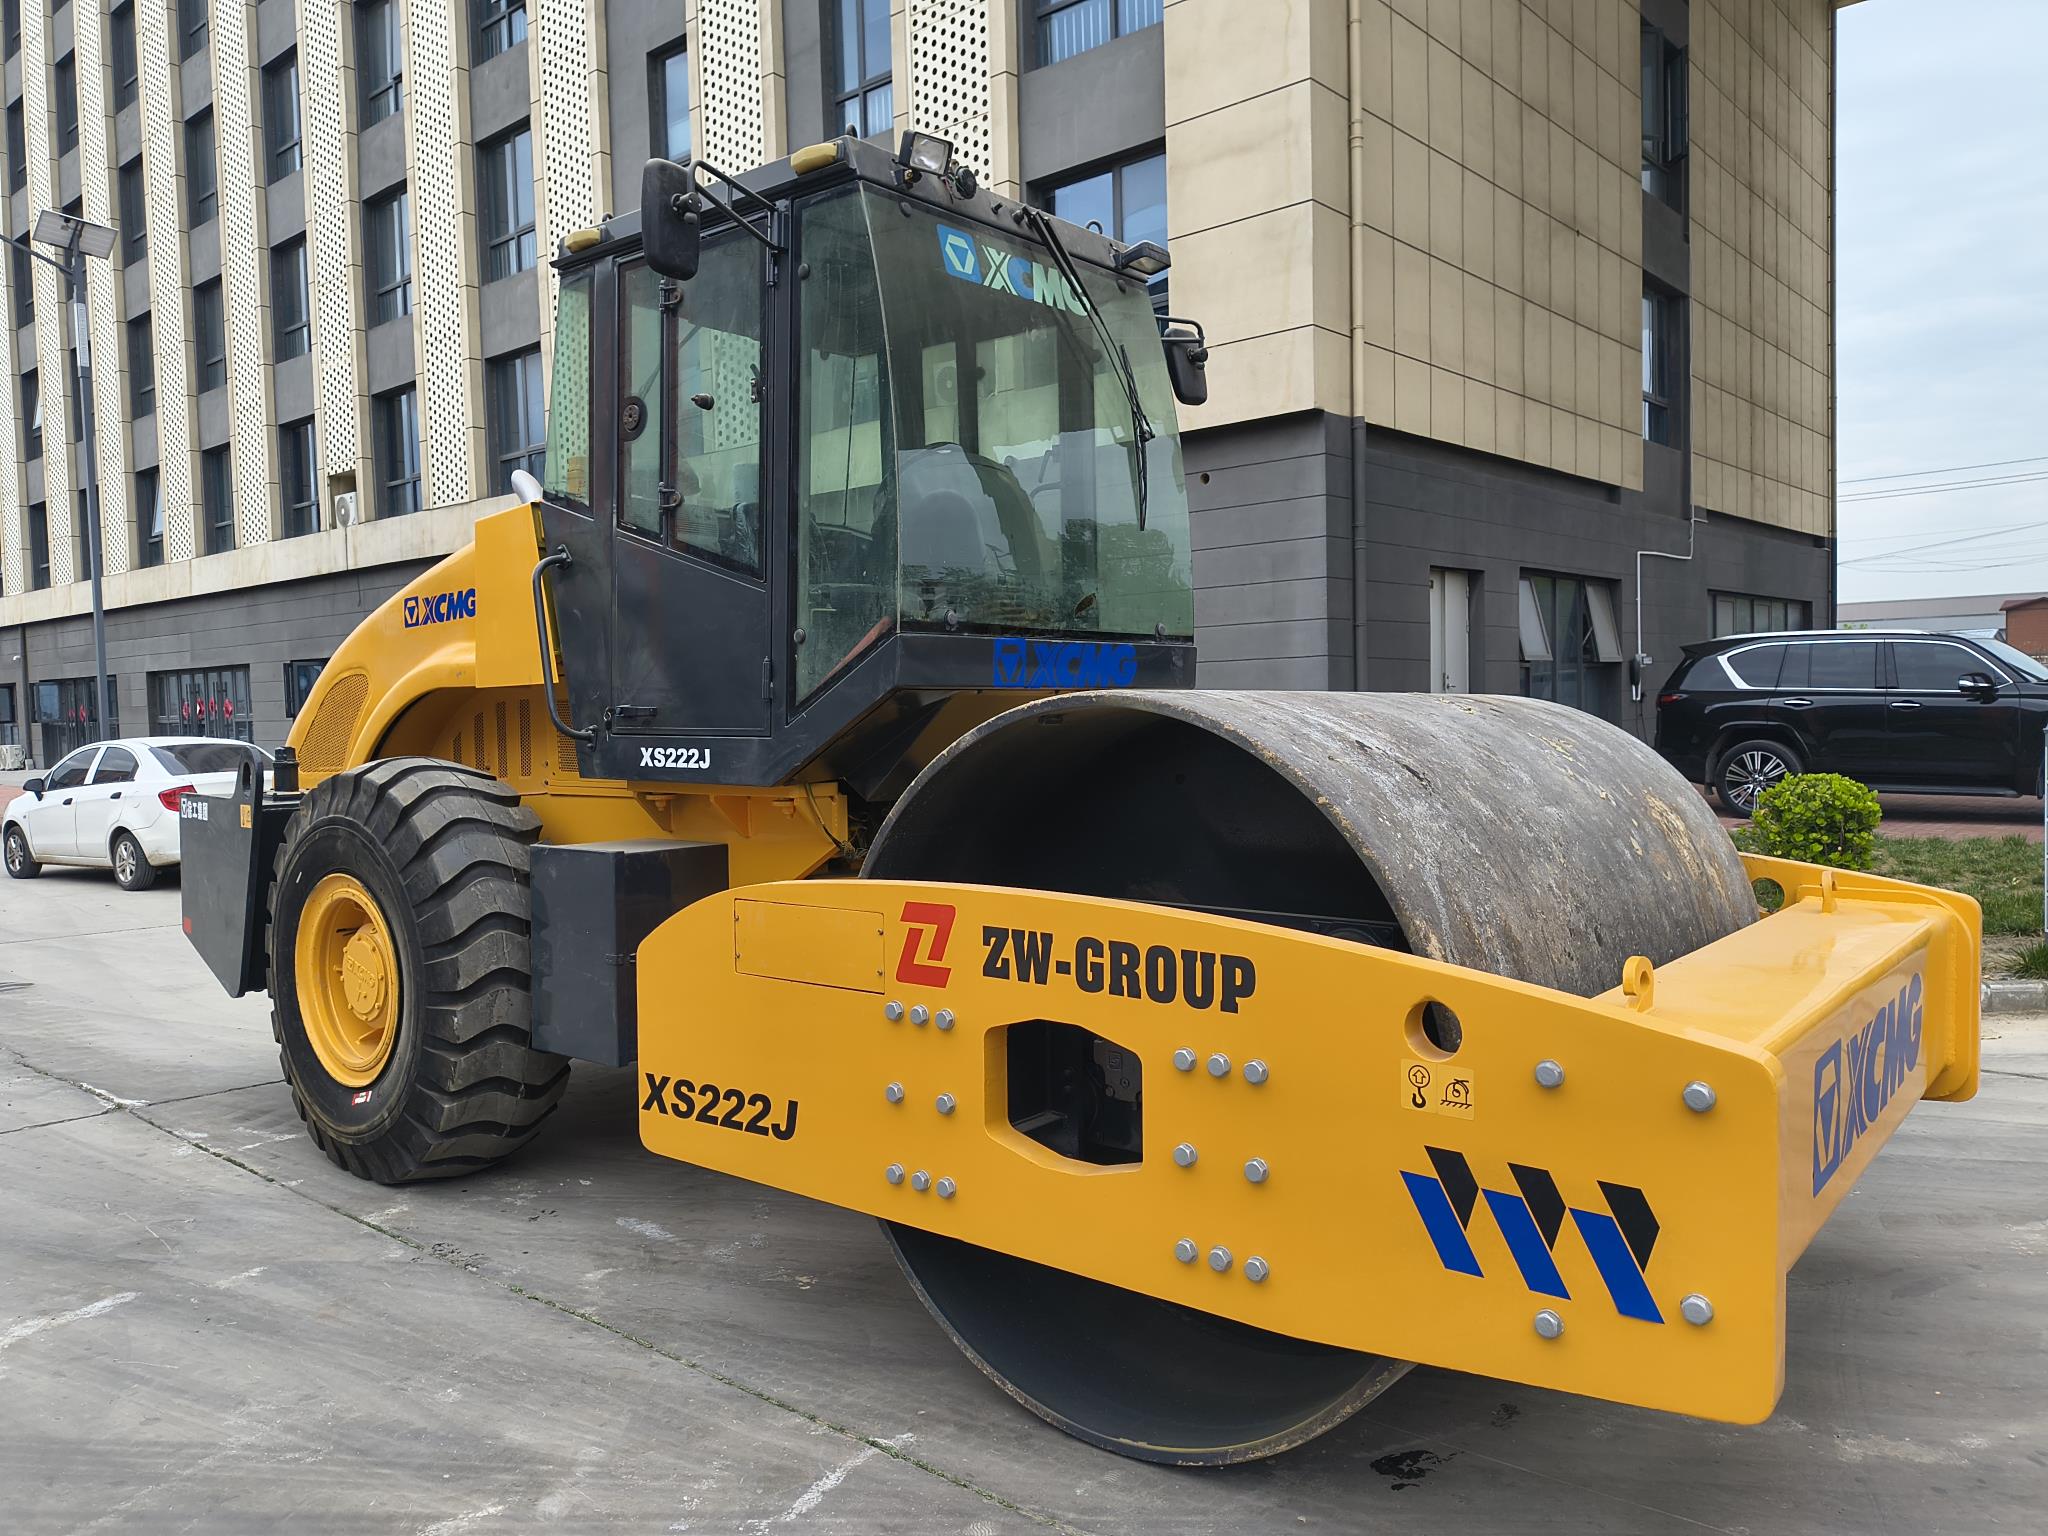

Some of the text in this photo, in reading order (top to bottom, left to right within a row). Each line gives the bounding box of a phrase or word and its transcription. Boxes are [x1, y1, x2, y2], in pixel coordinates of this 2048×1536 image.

[420, 588, 477, 626] XCMG
[1026, 643, 1138, 688] XCMG
[639, 747, 711, 769] XS222J
[982, 925, 1257, 1014] ZW-GROUP
[1840, 972, 1923, 1163] XCMG
[641, 1073, 799, 1141] XS222J
